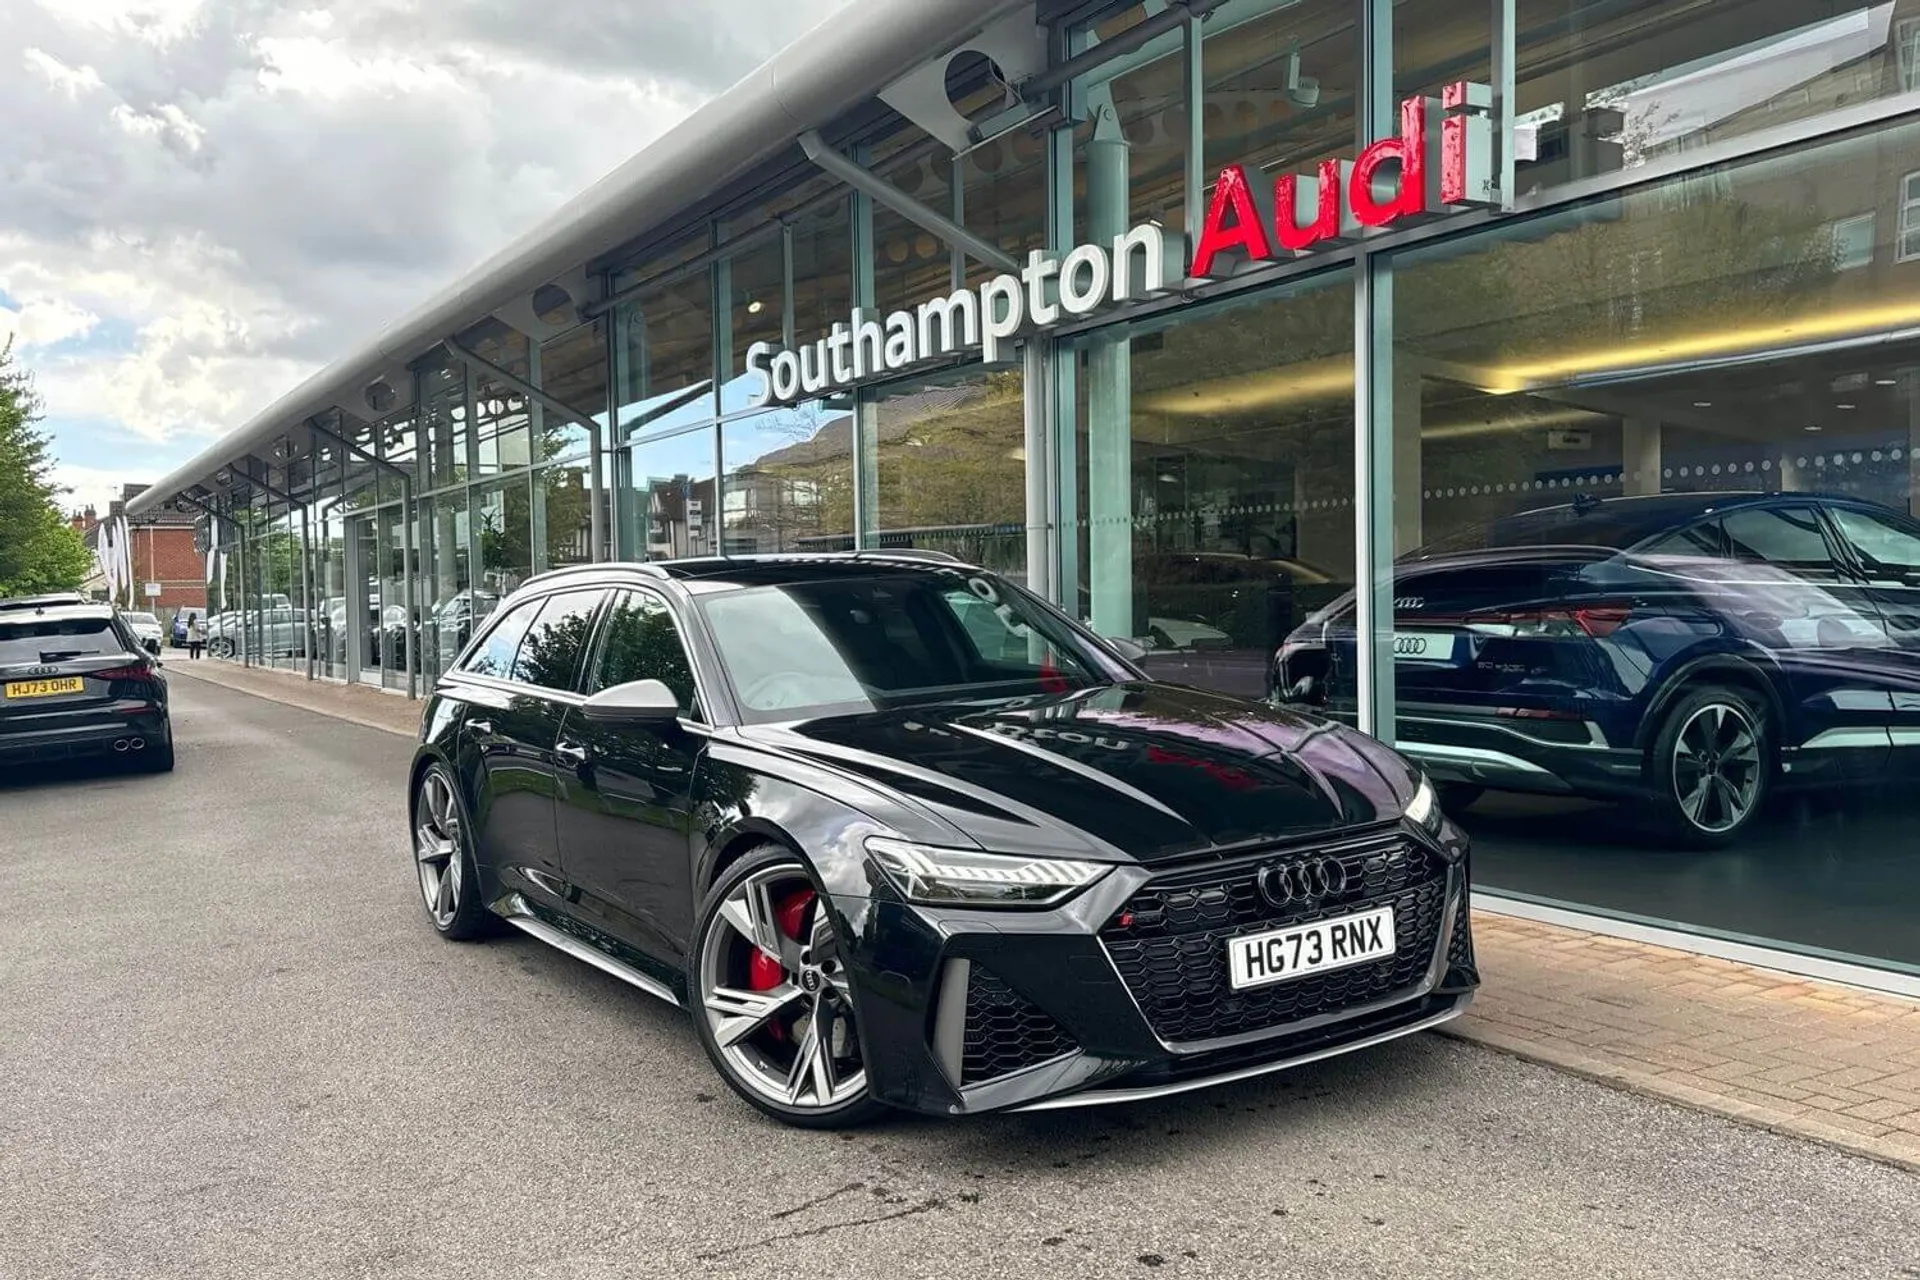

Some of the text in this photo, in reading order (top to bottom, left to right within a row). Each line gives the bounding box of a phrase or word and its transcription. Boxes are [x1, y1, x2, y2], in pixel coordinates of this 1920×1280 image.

[745, 81, 1468, 407] Southampton Audi
[12, 679, 77, 695] HJ73 OHR
[1245, 916, 1383, 979] HG73 RNX
